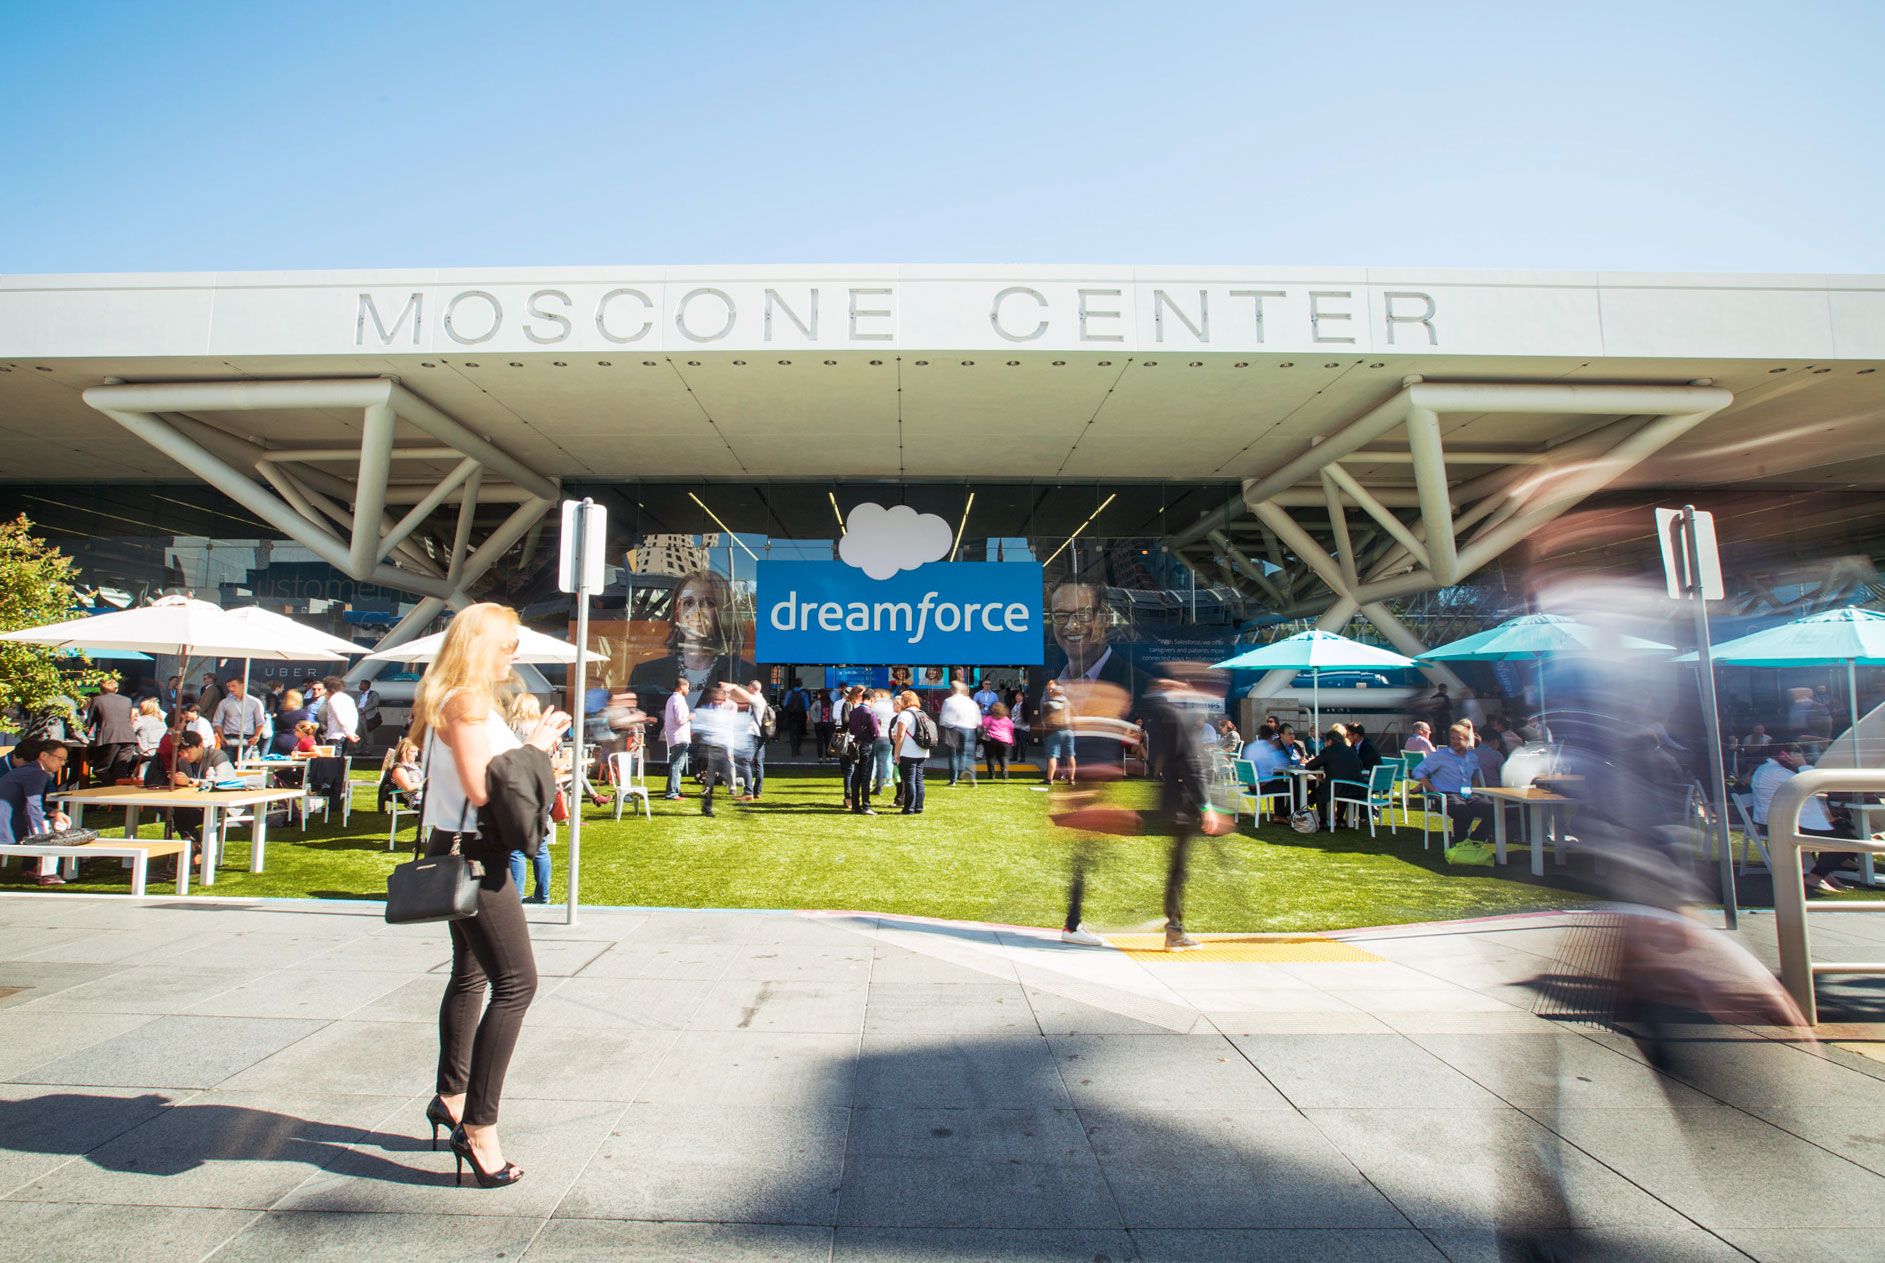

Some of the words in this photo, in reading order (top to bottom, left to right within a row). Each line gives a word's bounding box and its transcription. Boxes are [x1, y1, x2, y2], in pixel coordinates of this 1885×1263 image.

[355, 287, 894, 346] MOSCONE
[989, 286, 1438, 346] CENTER
[770, 590, 1030, 644] dreamforce
[265, 667, 317, 677] UBER
